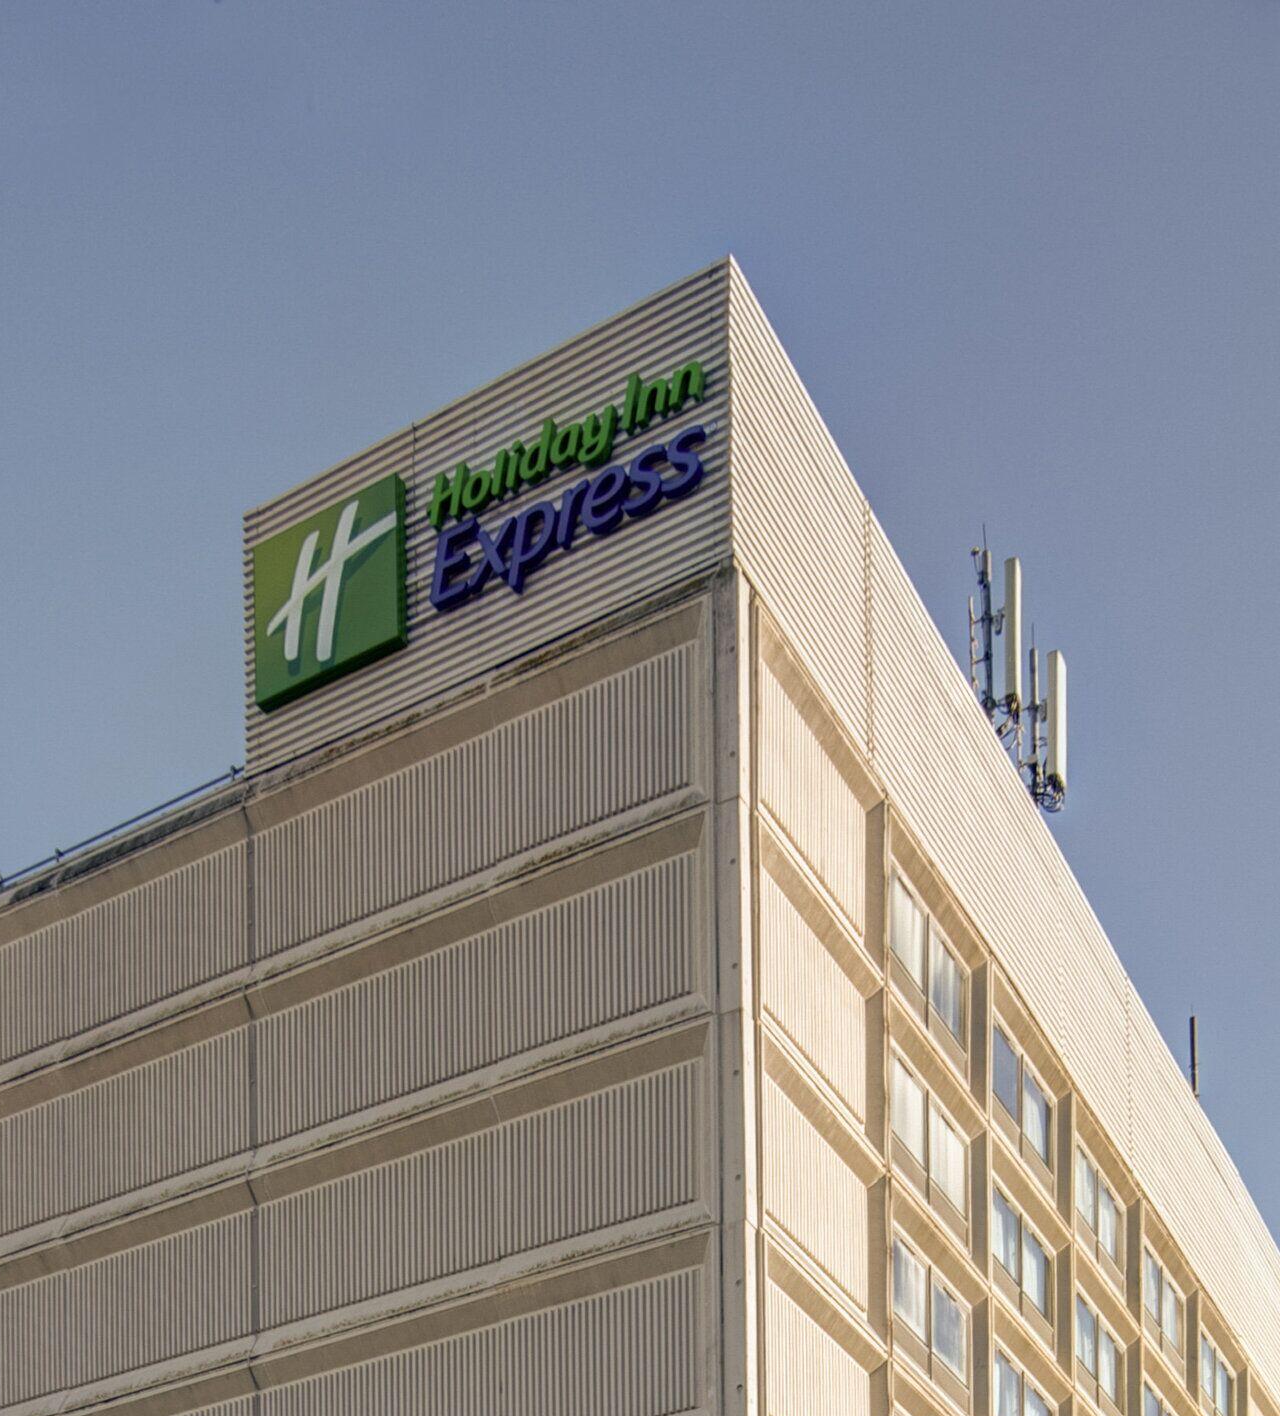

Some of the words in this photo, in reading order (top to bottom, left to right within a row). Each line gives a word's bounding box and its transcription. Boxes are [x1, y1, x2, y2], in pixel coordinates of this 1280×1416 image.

[427, 403, 618, 532] Holiday
[622, 361, 704, 435] Inn
[429, 424, 706, 612] Express
[267, 499, 397, 662] H
